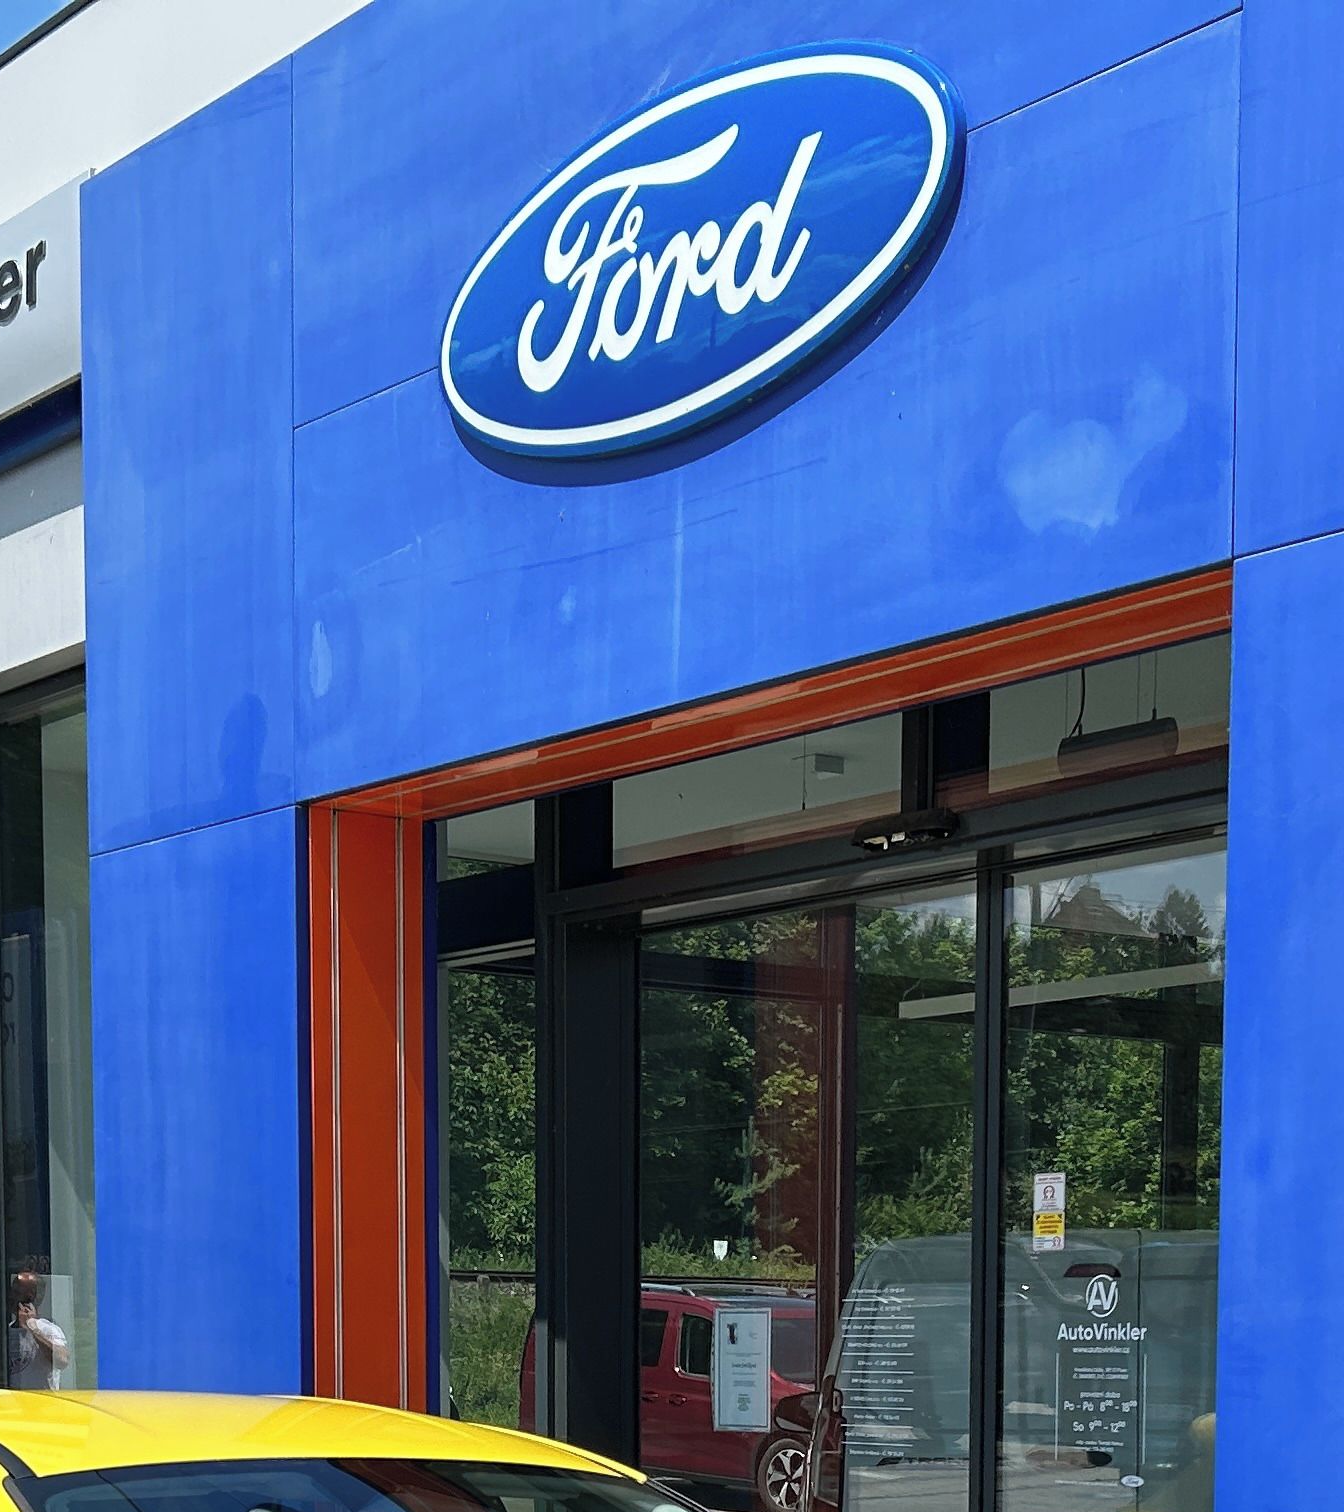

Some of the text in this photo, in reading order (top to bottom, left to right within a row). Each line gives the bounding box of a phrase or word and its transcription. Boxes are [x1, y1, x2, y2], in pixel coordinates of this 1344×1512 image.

[517, 123, 823, 393] Ford
[1057, 1322, 1148, 1340] AutoVinkler
[1072, 1421, 1085, 1432] So
